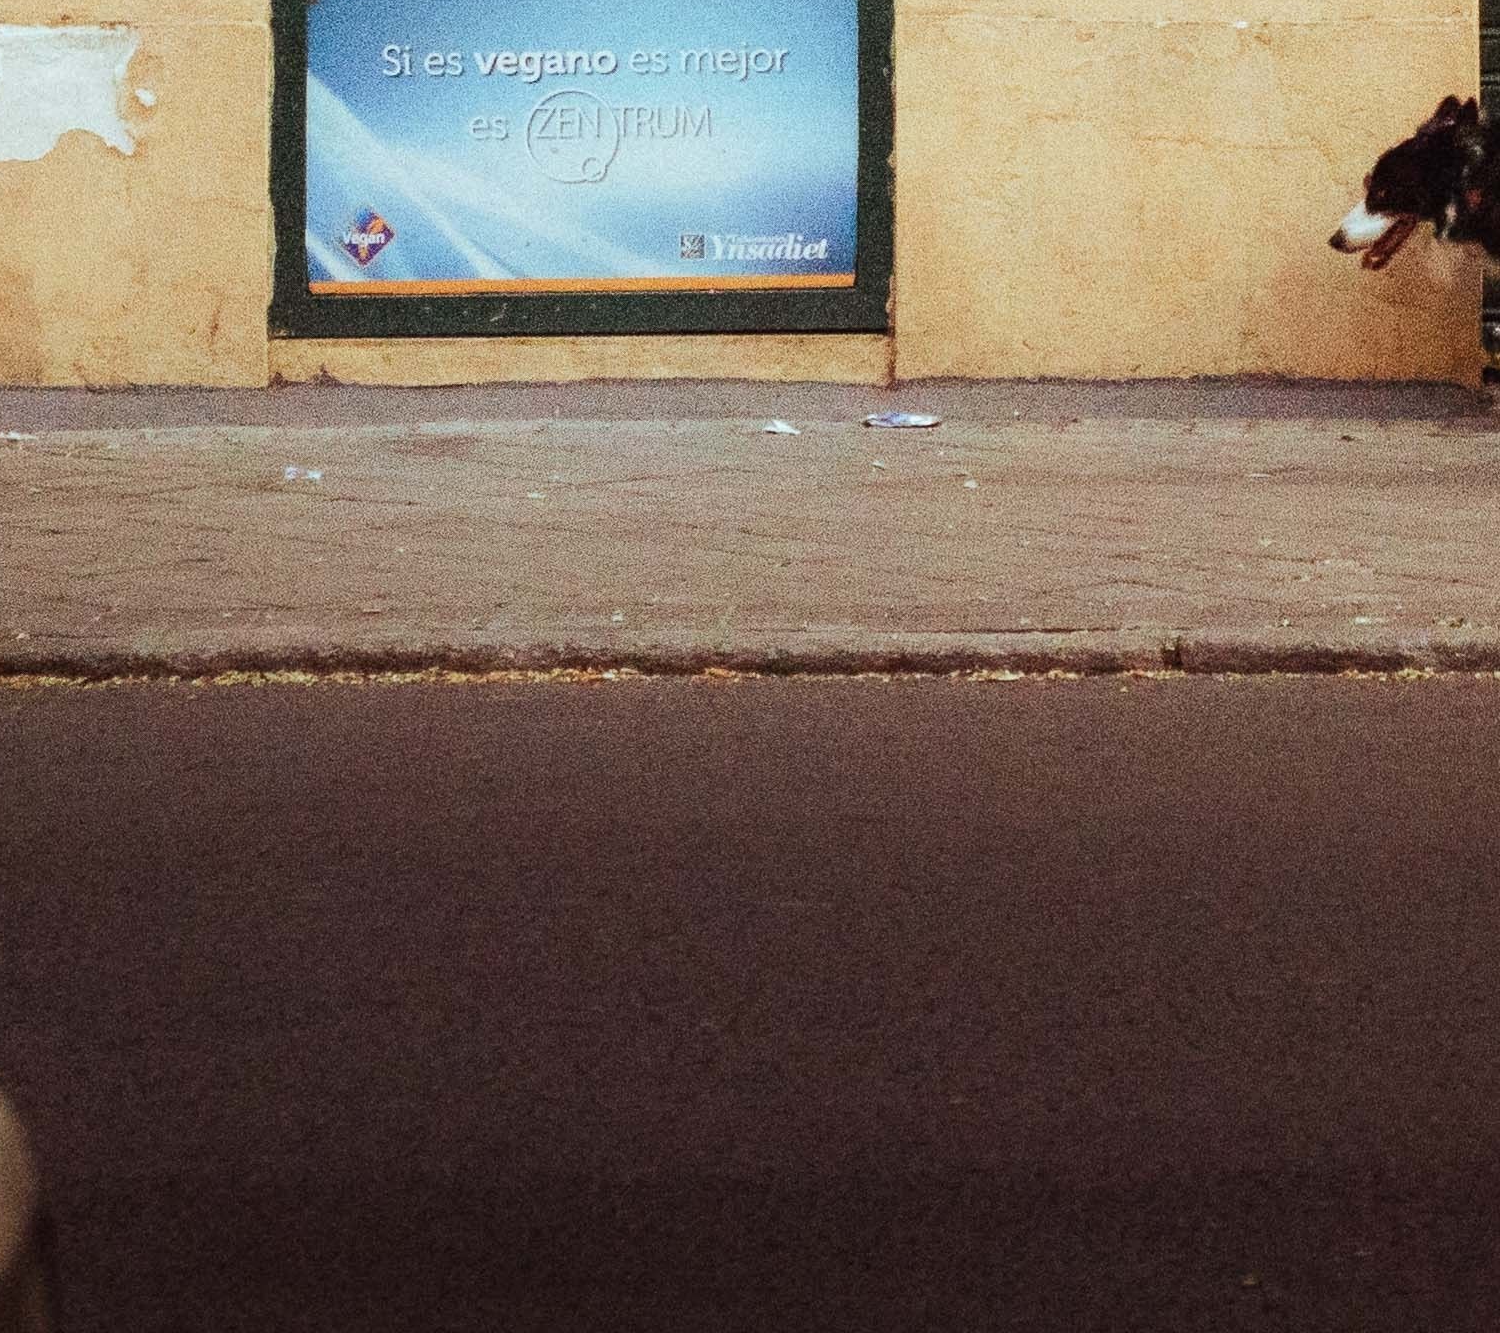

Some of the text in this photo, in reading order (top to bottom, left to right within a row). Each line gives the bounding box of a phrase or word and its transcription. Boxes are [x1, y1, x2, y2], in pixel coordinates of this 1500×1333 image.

[382, 43, 791, 84] Si es vegano es mejor
[468, 116, 510, 141] es
[342, 231, 385, 246] Vegan
[712, 232, 829, 261] Ynsadiet
